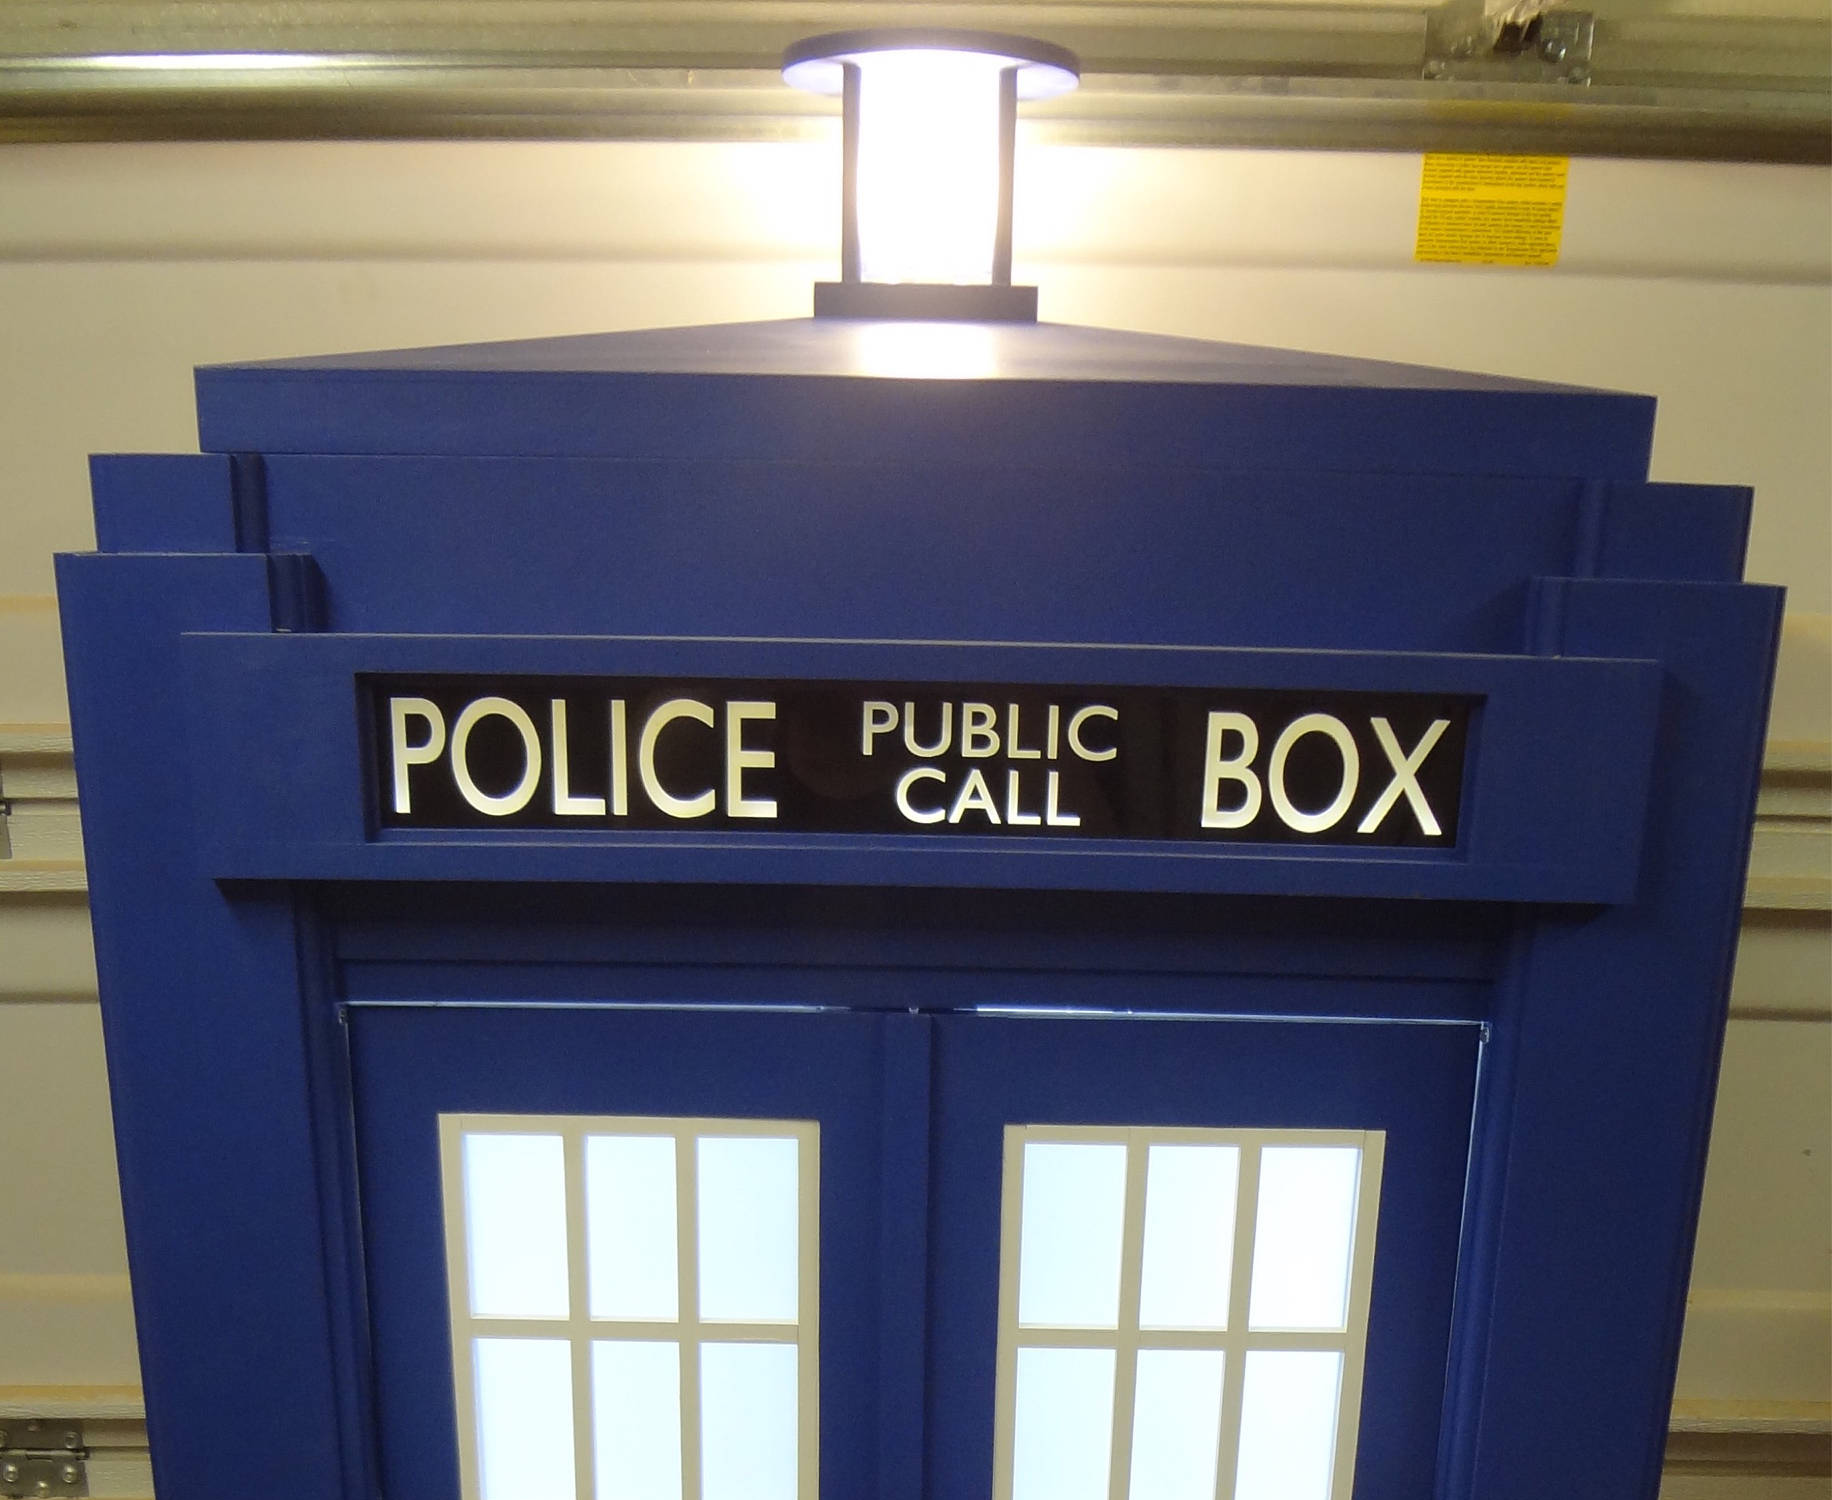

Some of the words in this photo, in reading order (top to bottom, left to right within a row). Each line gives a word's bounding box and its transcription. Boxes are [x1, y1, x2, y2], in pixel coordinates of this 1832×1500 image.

[390, 696, 778, 820] POLICE
[861, 699, 1120, 762] PUBLIC
[1201, 711, 1452, 836] BOX
[895, 767, 1082, 828] CALL
